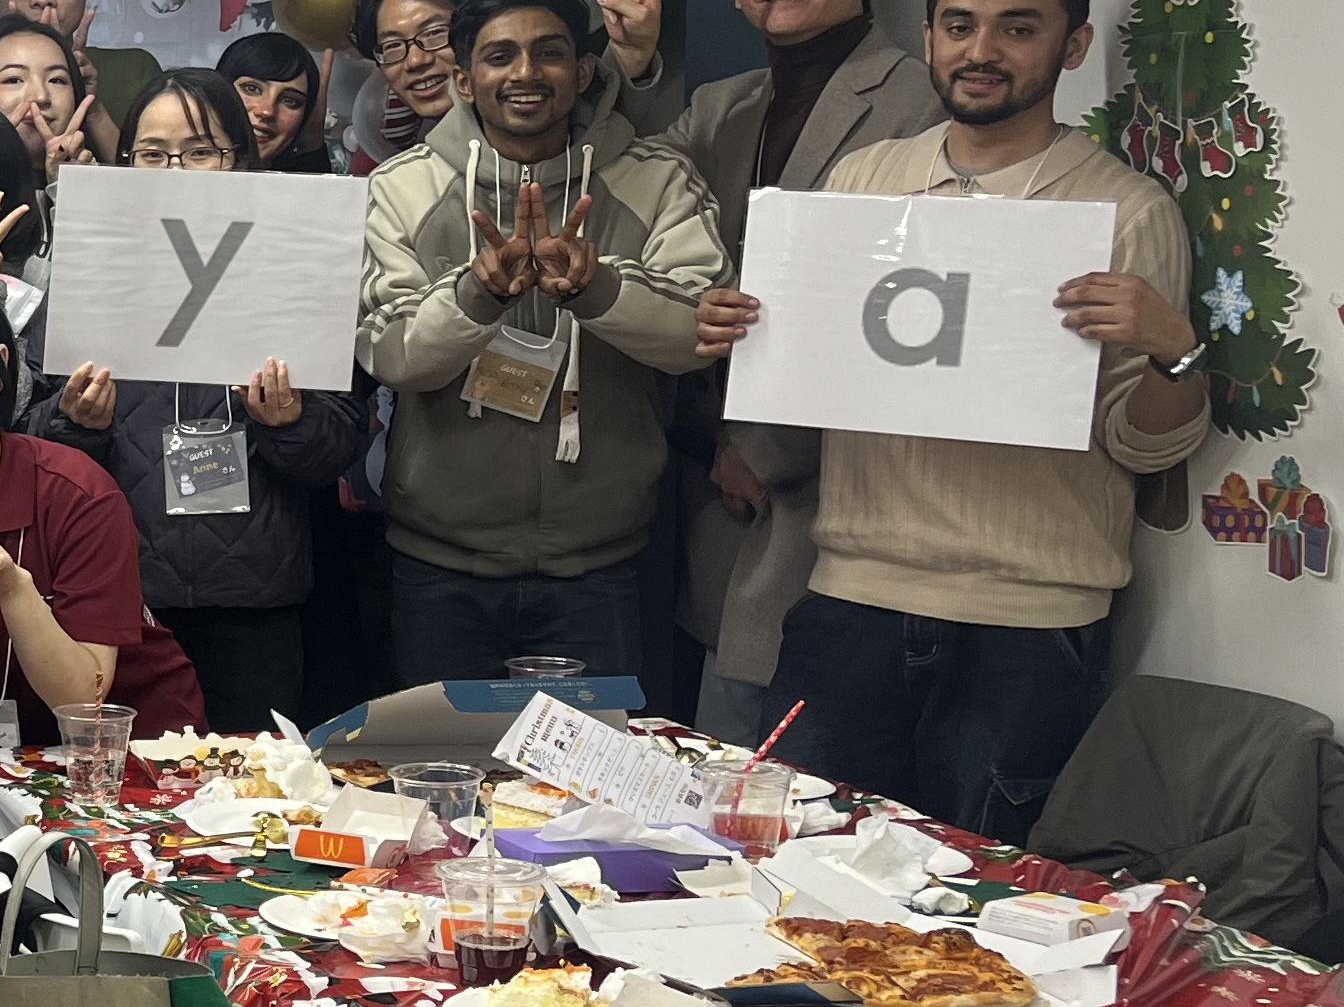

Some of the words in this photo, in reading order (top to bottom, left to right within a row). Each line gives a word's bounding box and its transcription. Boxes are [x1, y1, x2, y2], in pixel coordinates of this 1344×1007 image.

[155, 218, 254, 347] y
[862, 267, 971, 367] a
[500, 364, 528, 377] GUEST
[189, 448, 214, 461] GUEST
[192, 461, 219, 474] Anne
